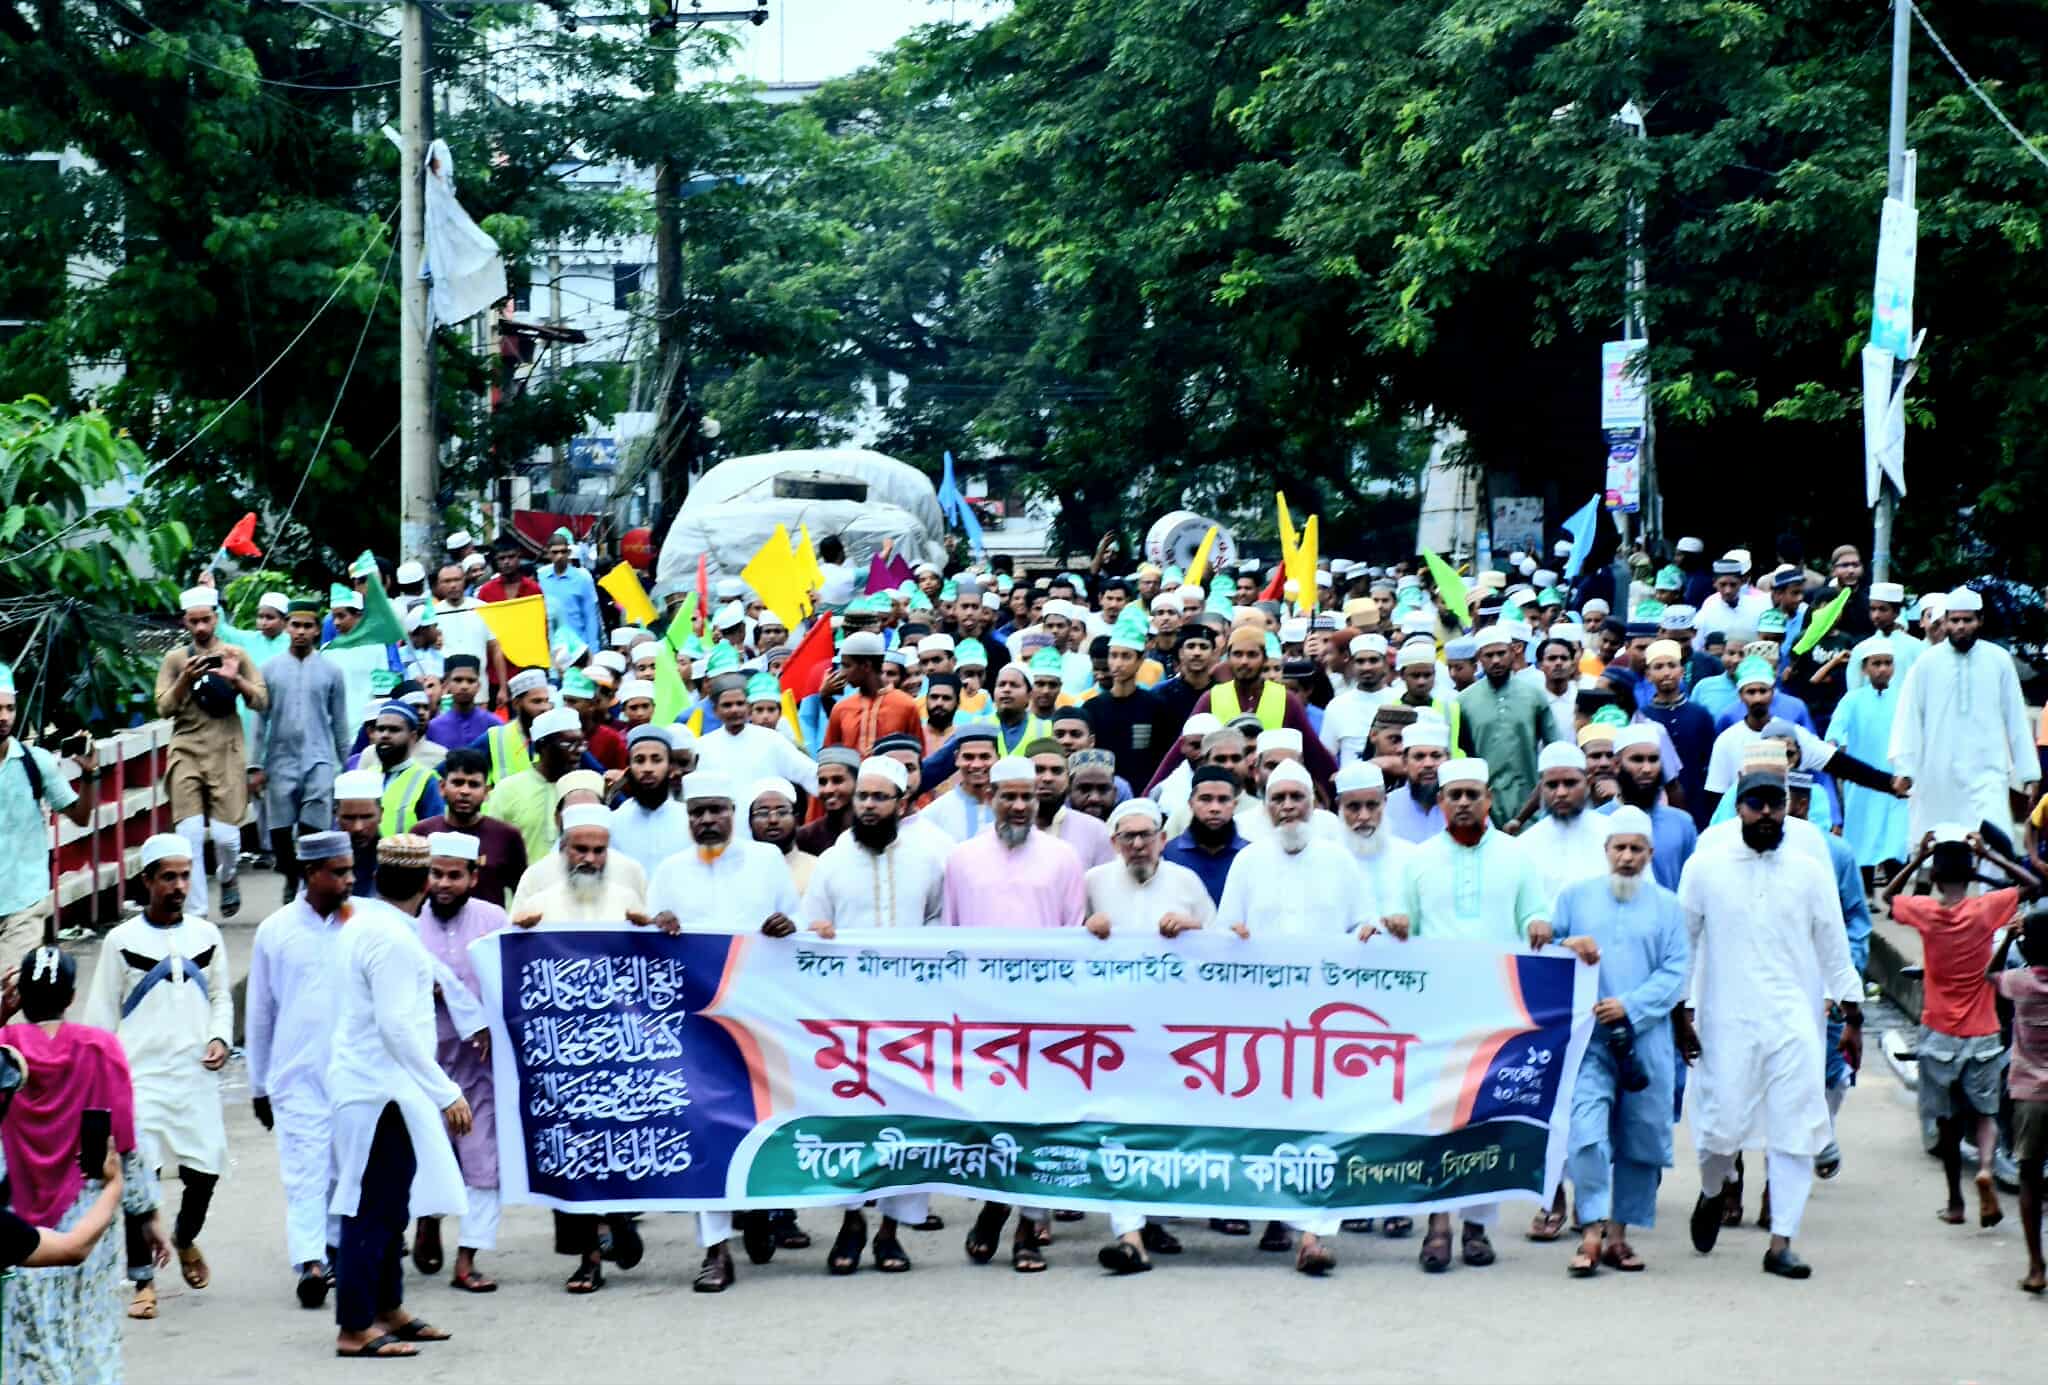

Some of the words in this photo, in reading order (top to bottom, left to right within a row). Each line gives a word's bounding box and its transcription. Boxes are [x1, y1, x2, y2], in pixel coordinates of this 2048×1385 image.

[796, 951, 847, 977] ঈদে
[857, 950, 969, 982] মীলাদুন্নবী
[1086, 953, 1183, 983] আলাইহি
[1199, 958, 1311, 988] ওয়াসাল্লাম
[796, 1013, 1136, 1107] মুবারক
[794, 1130, 866, 1180] ঈদে
[872, 1127, 1023, 1180] মীলাদুন্নবী
[1240, 1142, 1339, 1194] কমিটি
